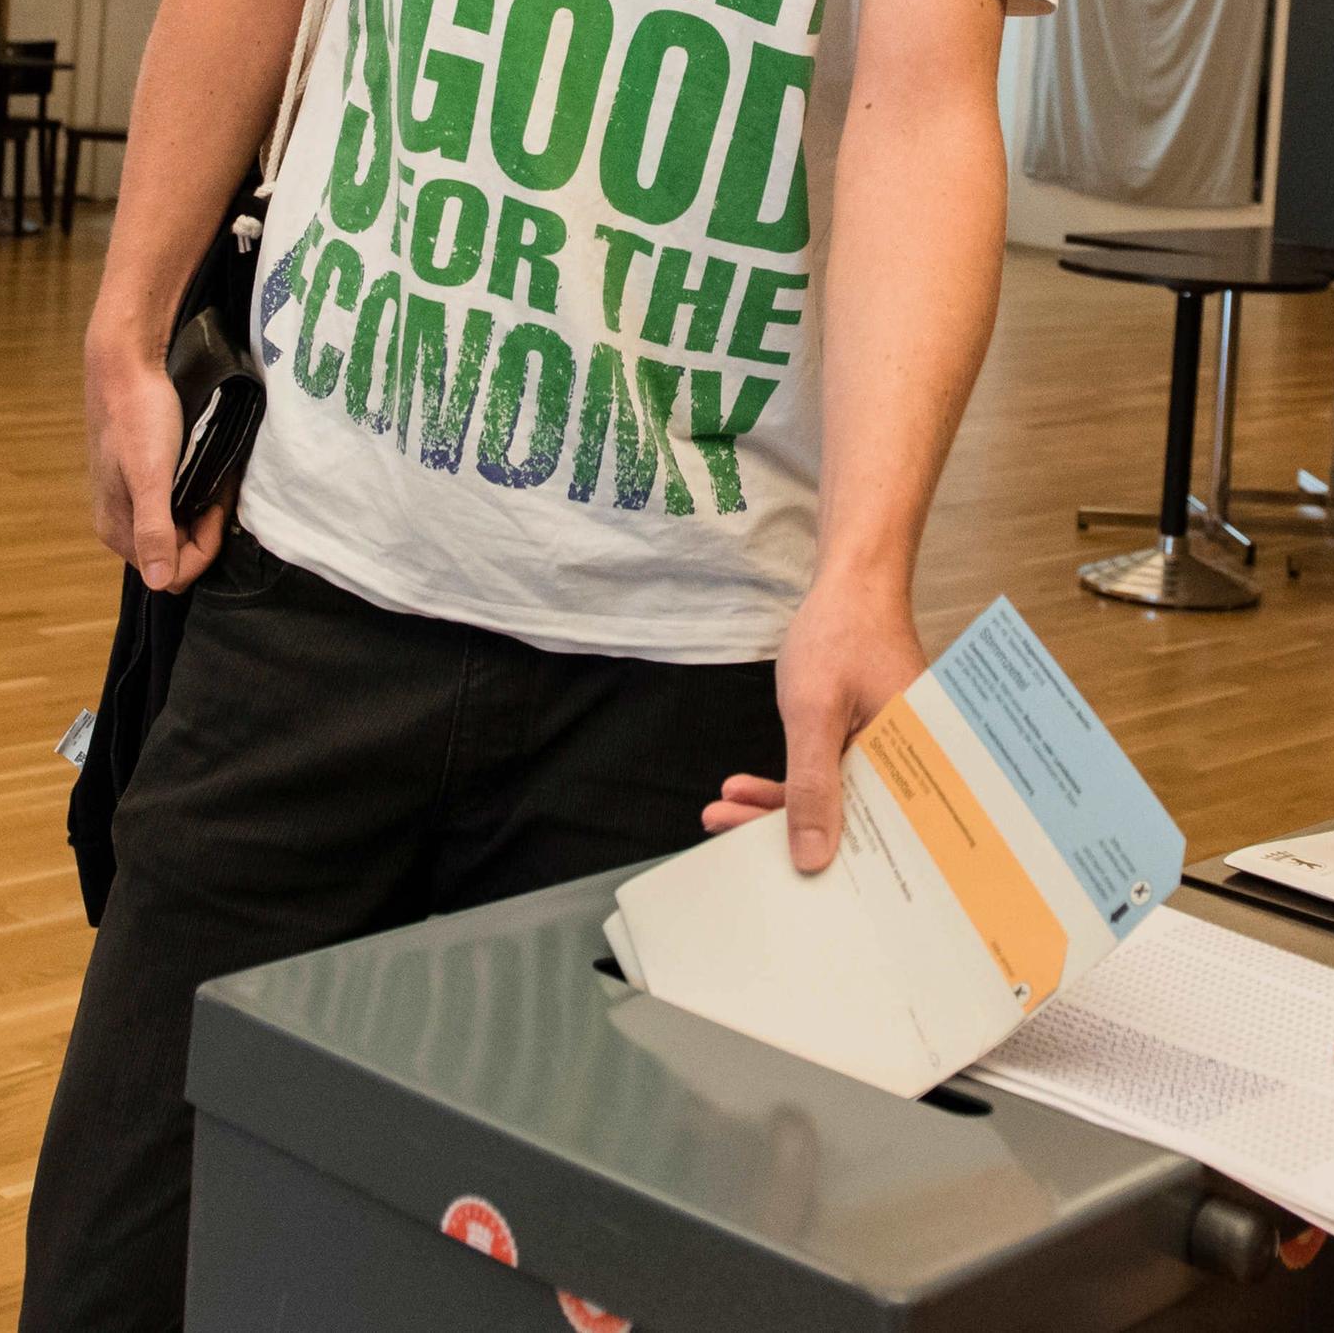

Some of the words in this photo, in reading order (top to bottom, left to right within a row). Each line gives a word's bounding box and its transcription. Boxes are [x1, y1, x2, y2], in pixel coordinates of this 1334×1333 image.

[260, 210, 781, 517] ECONOMY
[390, 157, 568, 314] FOR
[593, 223, 811, 366] THE
